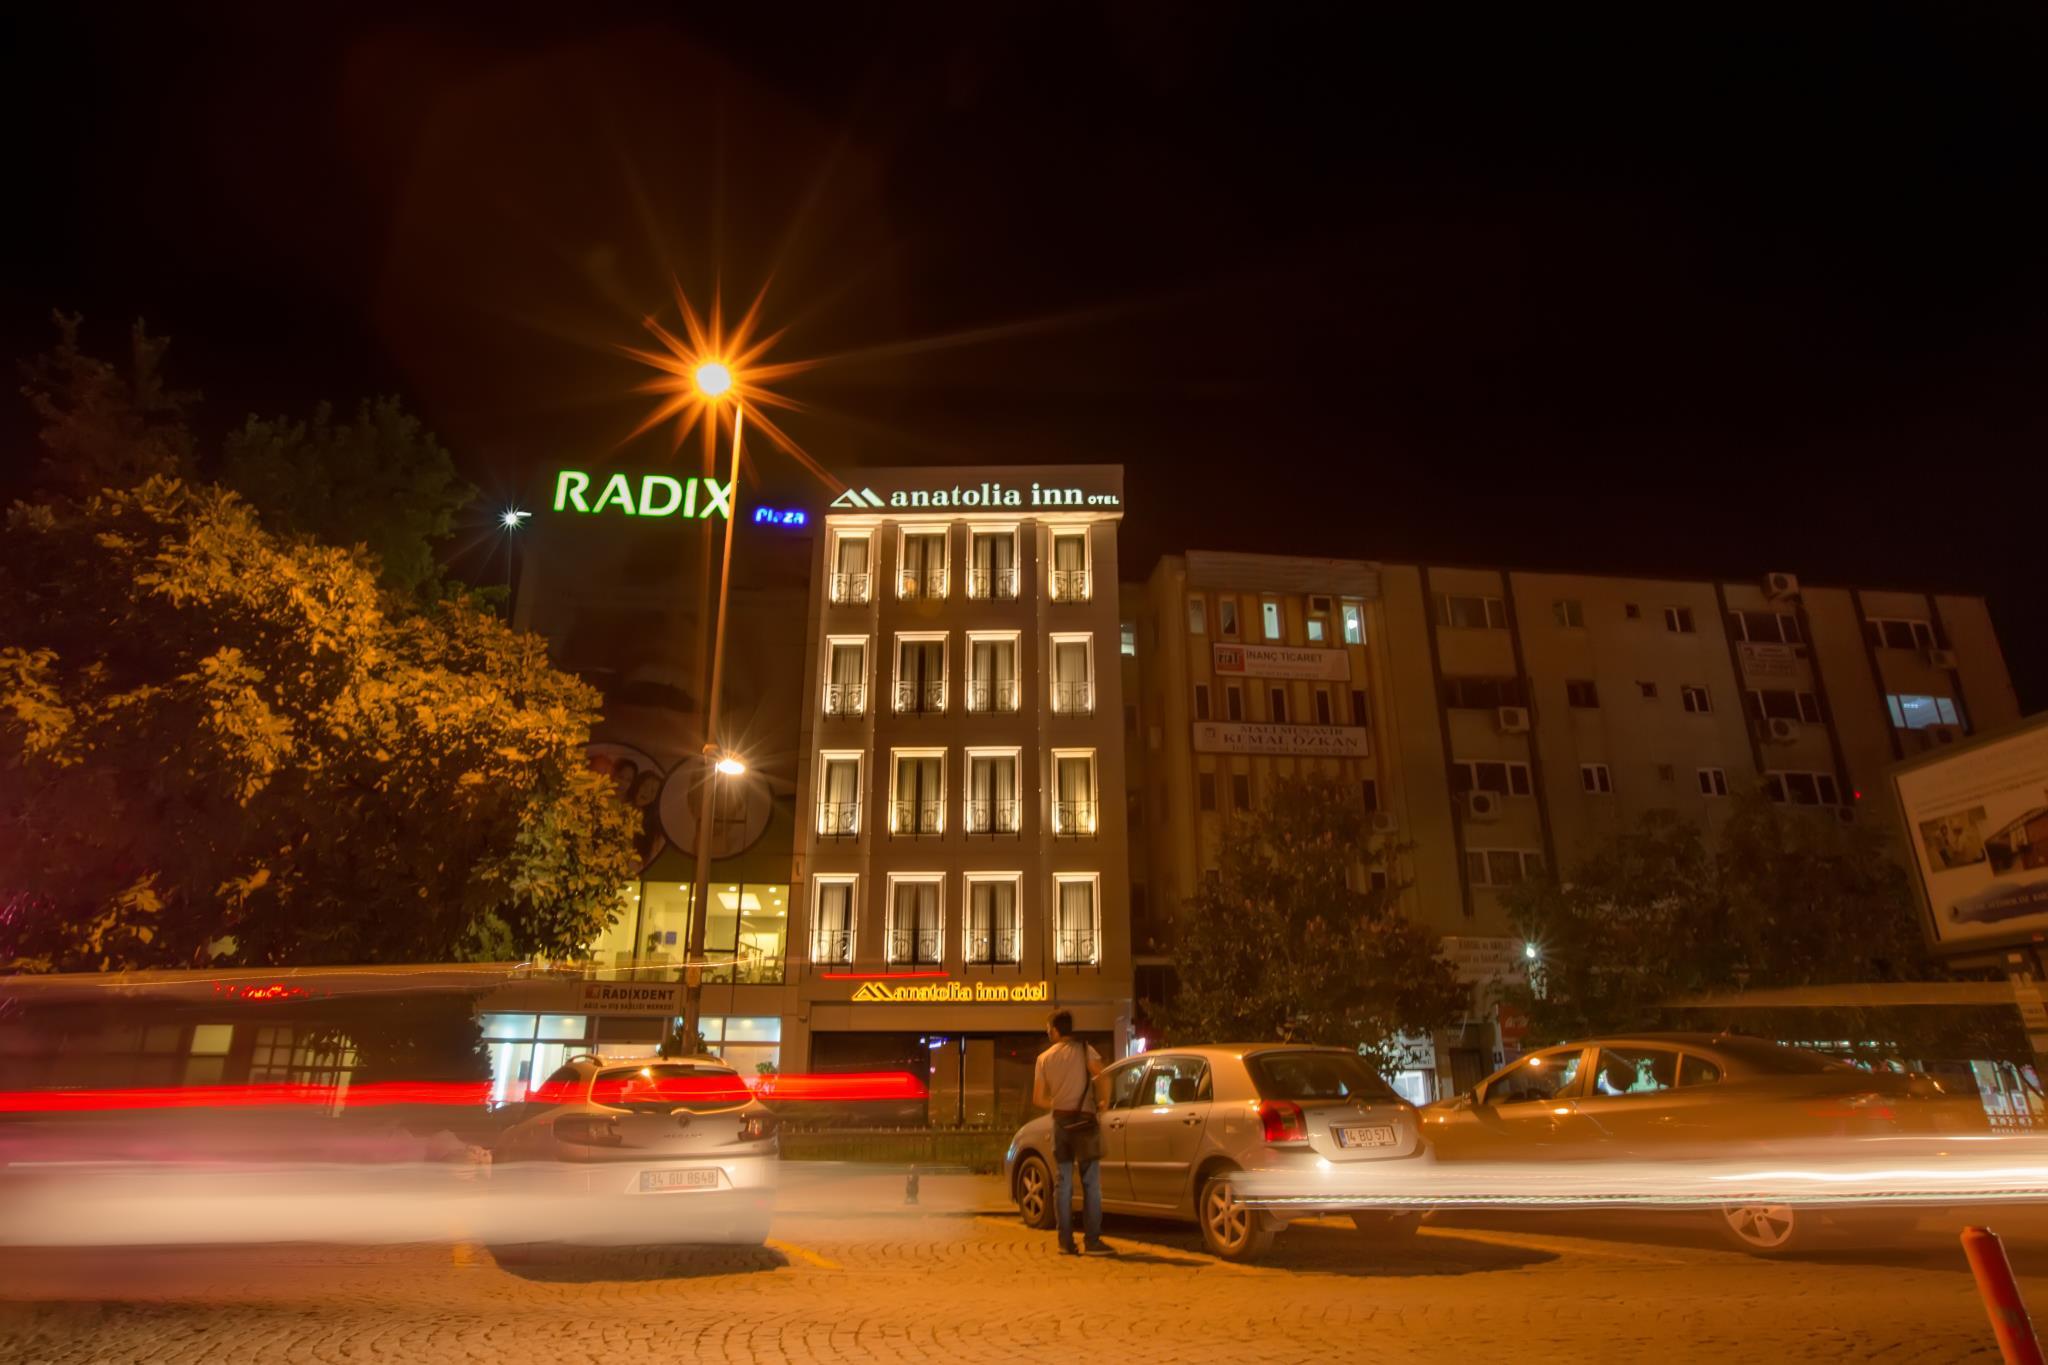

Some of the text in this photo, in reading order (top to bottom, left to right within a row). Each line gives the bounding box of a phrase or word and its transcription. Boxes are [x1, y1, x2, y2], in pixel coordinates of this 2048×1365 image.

[552, 469, 733, 520] RADIX
[890, 482, 1120, 507] anatolia inn OTEL
[1223, 734, 1288, 746] KEMAL
[602, 988, 675, 1000] RADIXDENT
[893, 981, 1047, 1002] anatolia inn otel
[1345, 1129, 1356, 1143] 14
[1374, 1127, 1392, 1141] 571
[648, 1173, 663, 1187] 34
